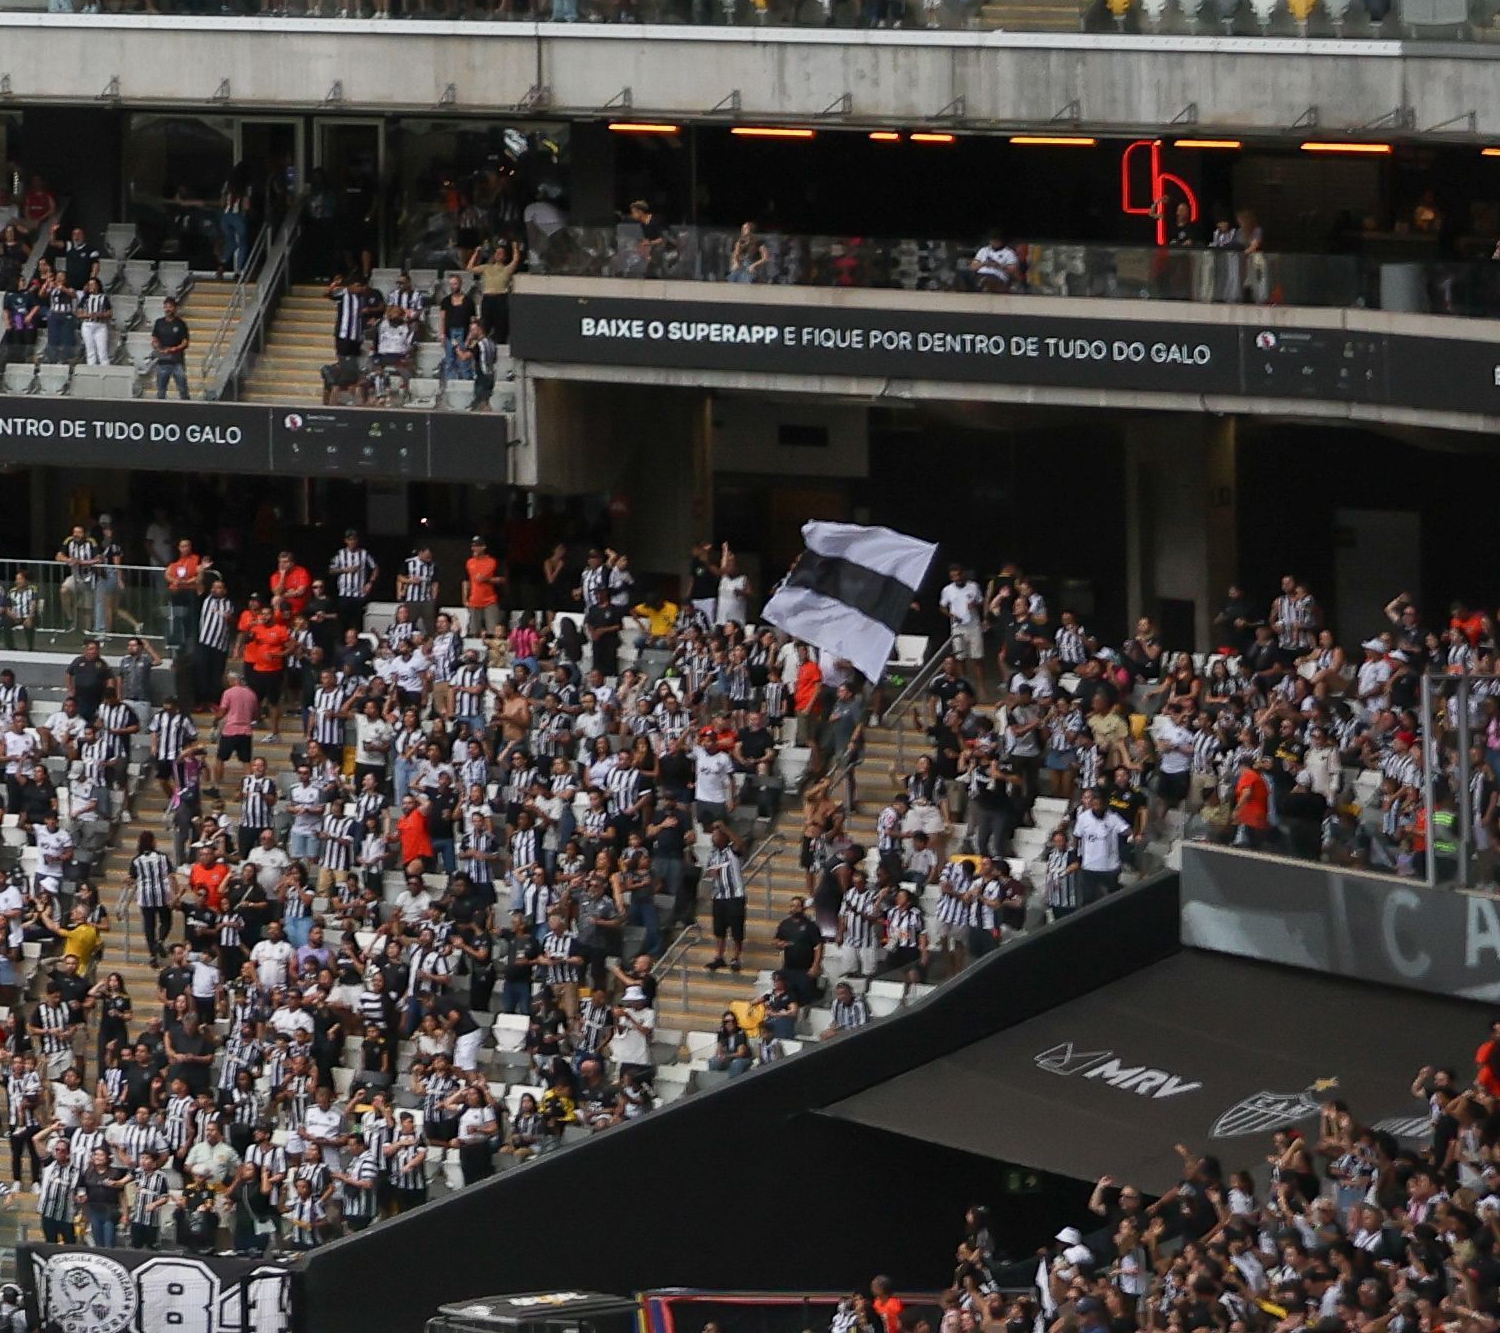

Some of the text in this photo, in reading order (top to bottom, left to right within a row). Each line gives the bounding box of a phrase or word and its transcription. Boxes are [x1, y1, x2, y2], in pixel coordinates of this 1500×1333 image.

[581, 317, 1211, 365] BAIXE O SUPERAPP E FIQUE POR DENTRO DE TUDO DO GALO
[59, 419, 87, 438] DE
[91, 420, 145, 441] TUDO
[149, 423, 181, 442] DO
[185, 424, 242, 445] GALO
[1082, 1057, 1204, 1100] MRV
